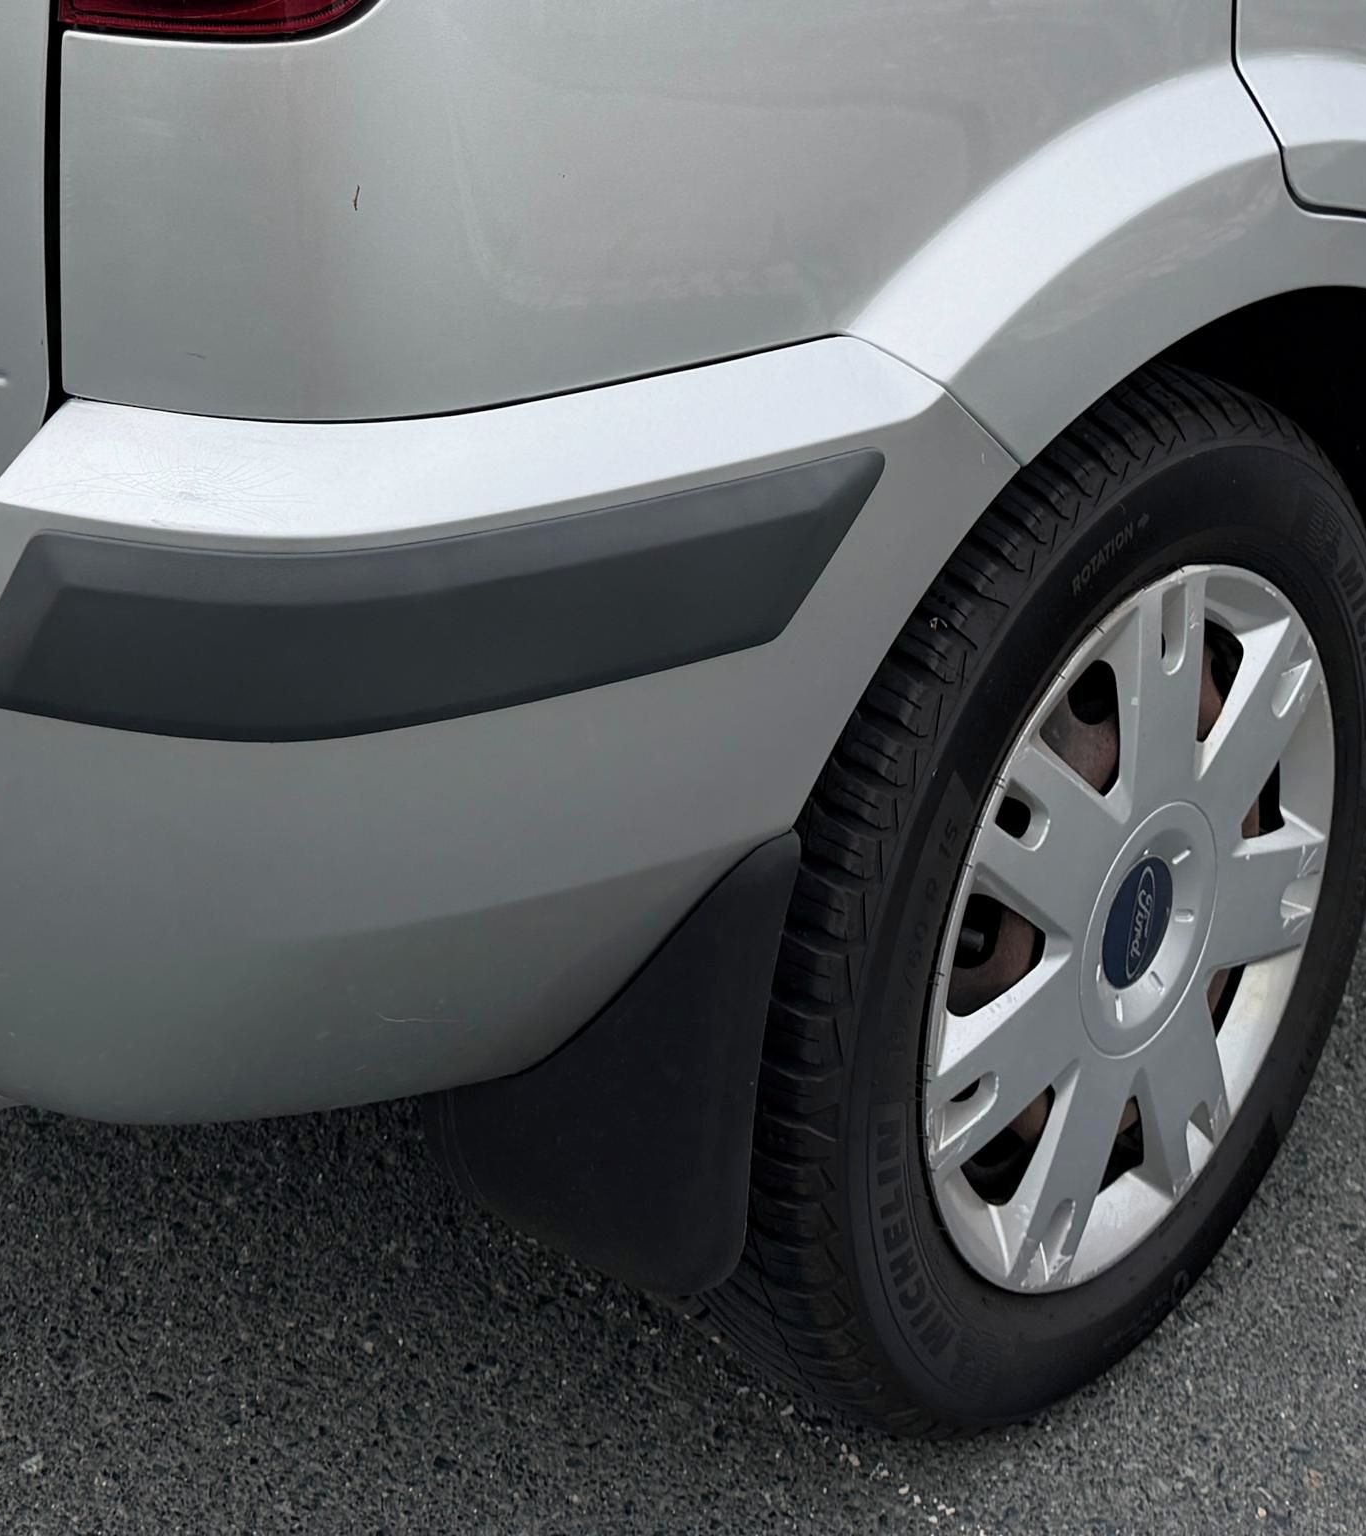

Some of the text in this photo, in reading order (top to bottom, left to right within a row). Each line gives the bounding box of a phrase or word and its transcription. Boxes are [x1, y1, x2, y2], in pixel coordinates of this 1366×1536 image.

[1072, 521, 1134, 598] ROTATION
[1129, 888, 1154, 961] Ford
[875, 1118, 956, 1360] MICHELIN
